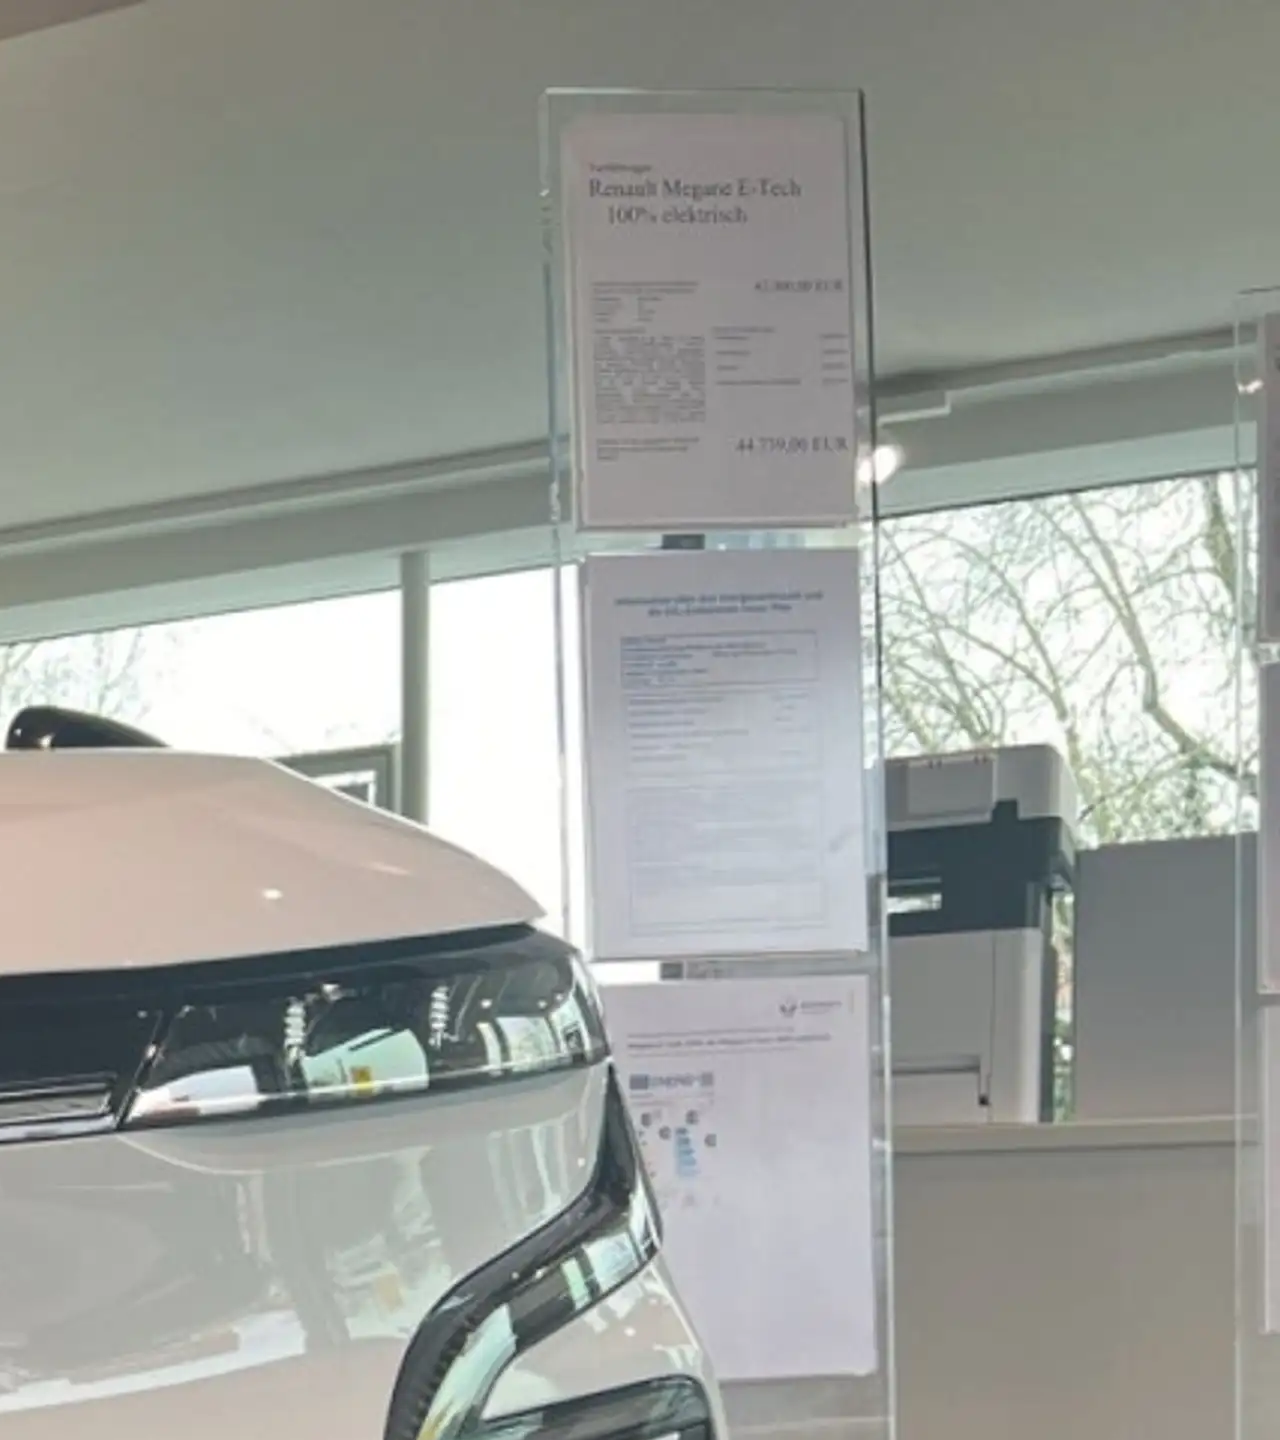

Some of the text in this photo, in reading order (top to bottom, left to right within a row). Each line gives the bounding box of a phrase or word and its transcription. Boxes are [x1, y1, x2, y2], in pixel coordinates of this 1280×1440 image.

[590, 178, 657, 198] Renault
[736, 178, 803, 198] E-Tech
[608, 205, 749, 225] 100% elektrisch
